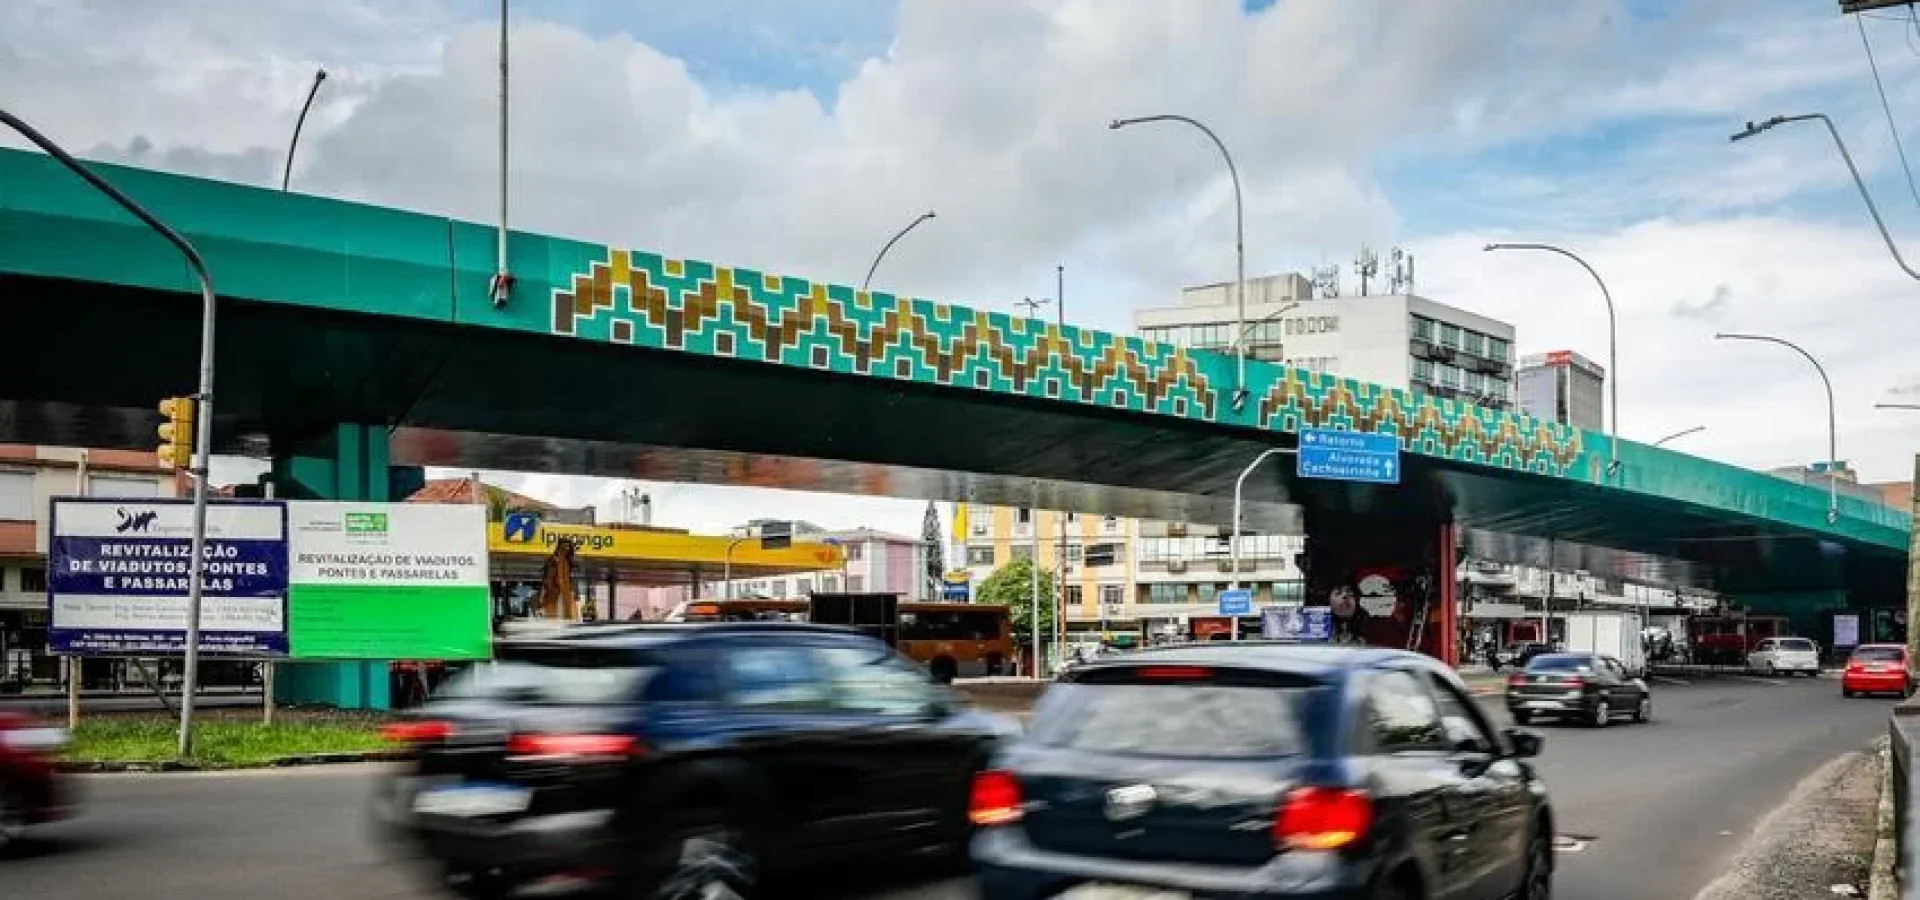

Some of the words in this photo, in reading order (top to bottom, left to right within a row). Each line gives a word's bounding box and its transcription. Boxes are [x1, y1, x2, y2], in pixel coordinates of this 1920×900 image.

[1318, 433, 1365, 448] Retorno
[1327, 451, 1379, 467] Alvorada
[1302, 461, 1379, 478] Cachoeirinha
[100, 543, 238, 559] REVITALIZÇÃO
[70, 560, 93, 571] DE
[395, 555, 412, 565] DE
[318, 567, 367, 578] PONTES
[370, 568, 377, 578] E
[381, 568, 460, 580] PASSARELAS
[103, 577, 114, 589] E
[121, 577, 234, 590] PASSARLAS
